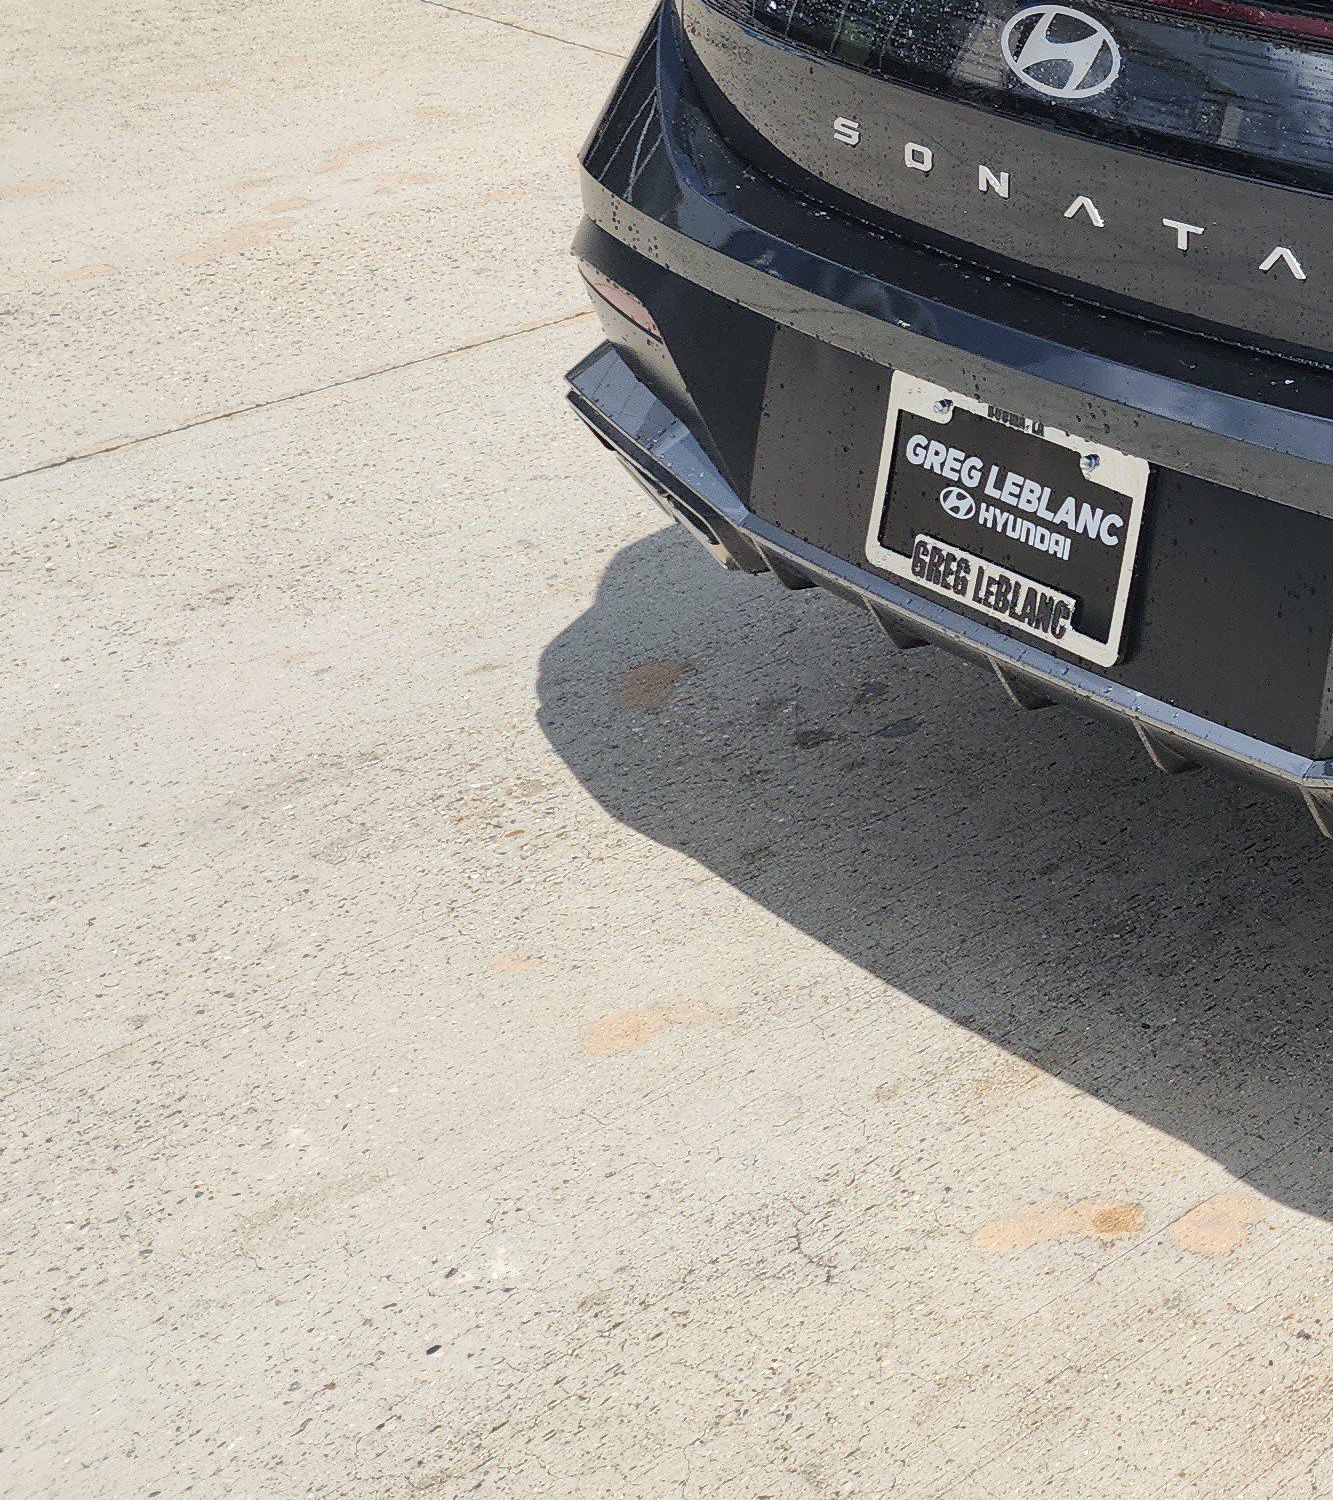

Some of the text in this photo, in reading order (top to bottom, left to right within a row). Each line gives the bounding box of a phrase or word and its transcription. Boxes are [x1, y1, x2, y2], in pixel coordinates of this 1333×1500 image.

[833, 116, 1307, 281] SONATA
[905, 434, 1123, 546] GREG LEBLANC
[978, 502, 1072, 561] HYUNDAI
[911, 539, 972, 597] GREG
